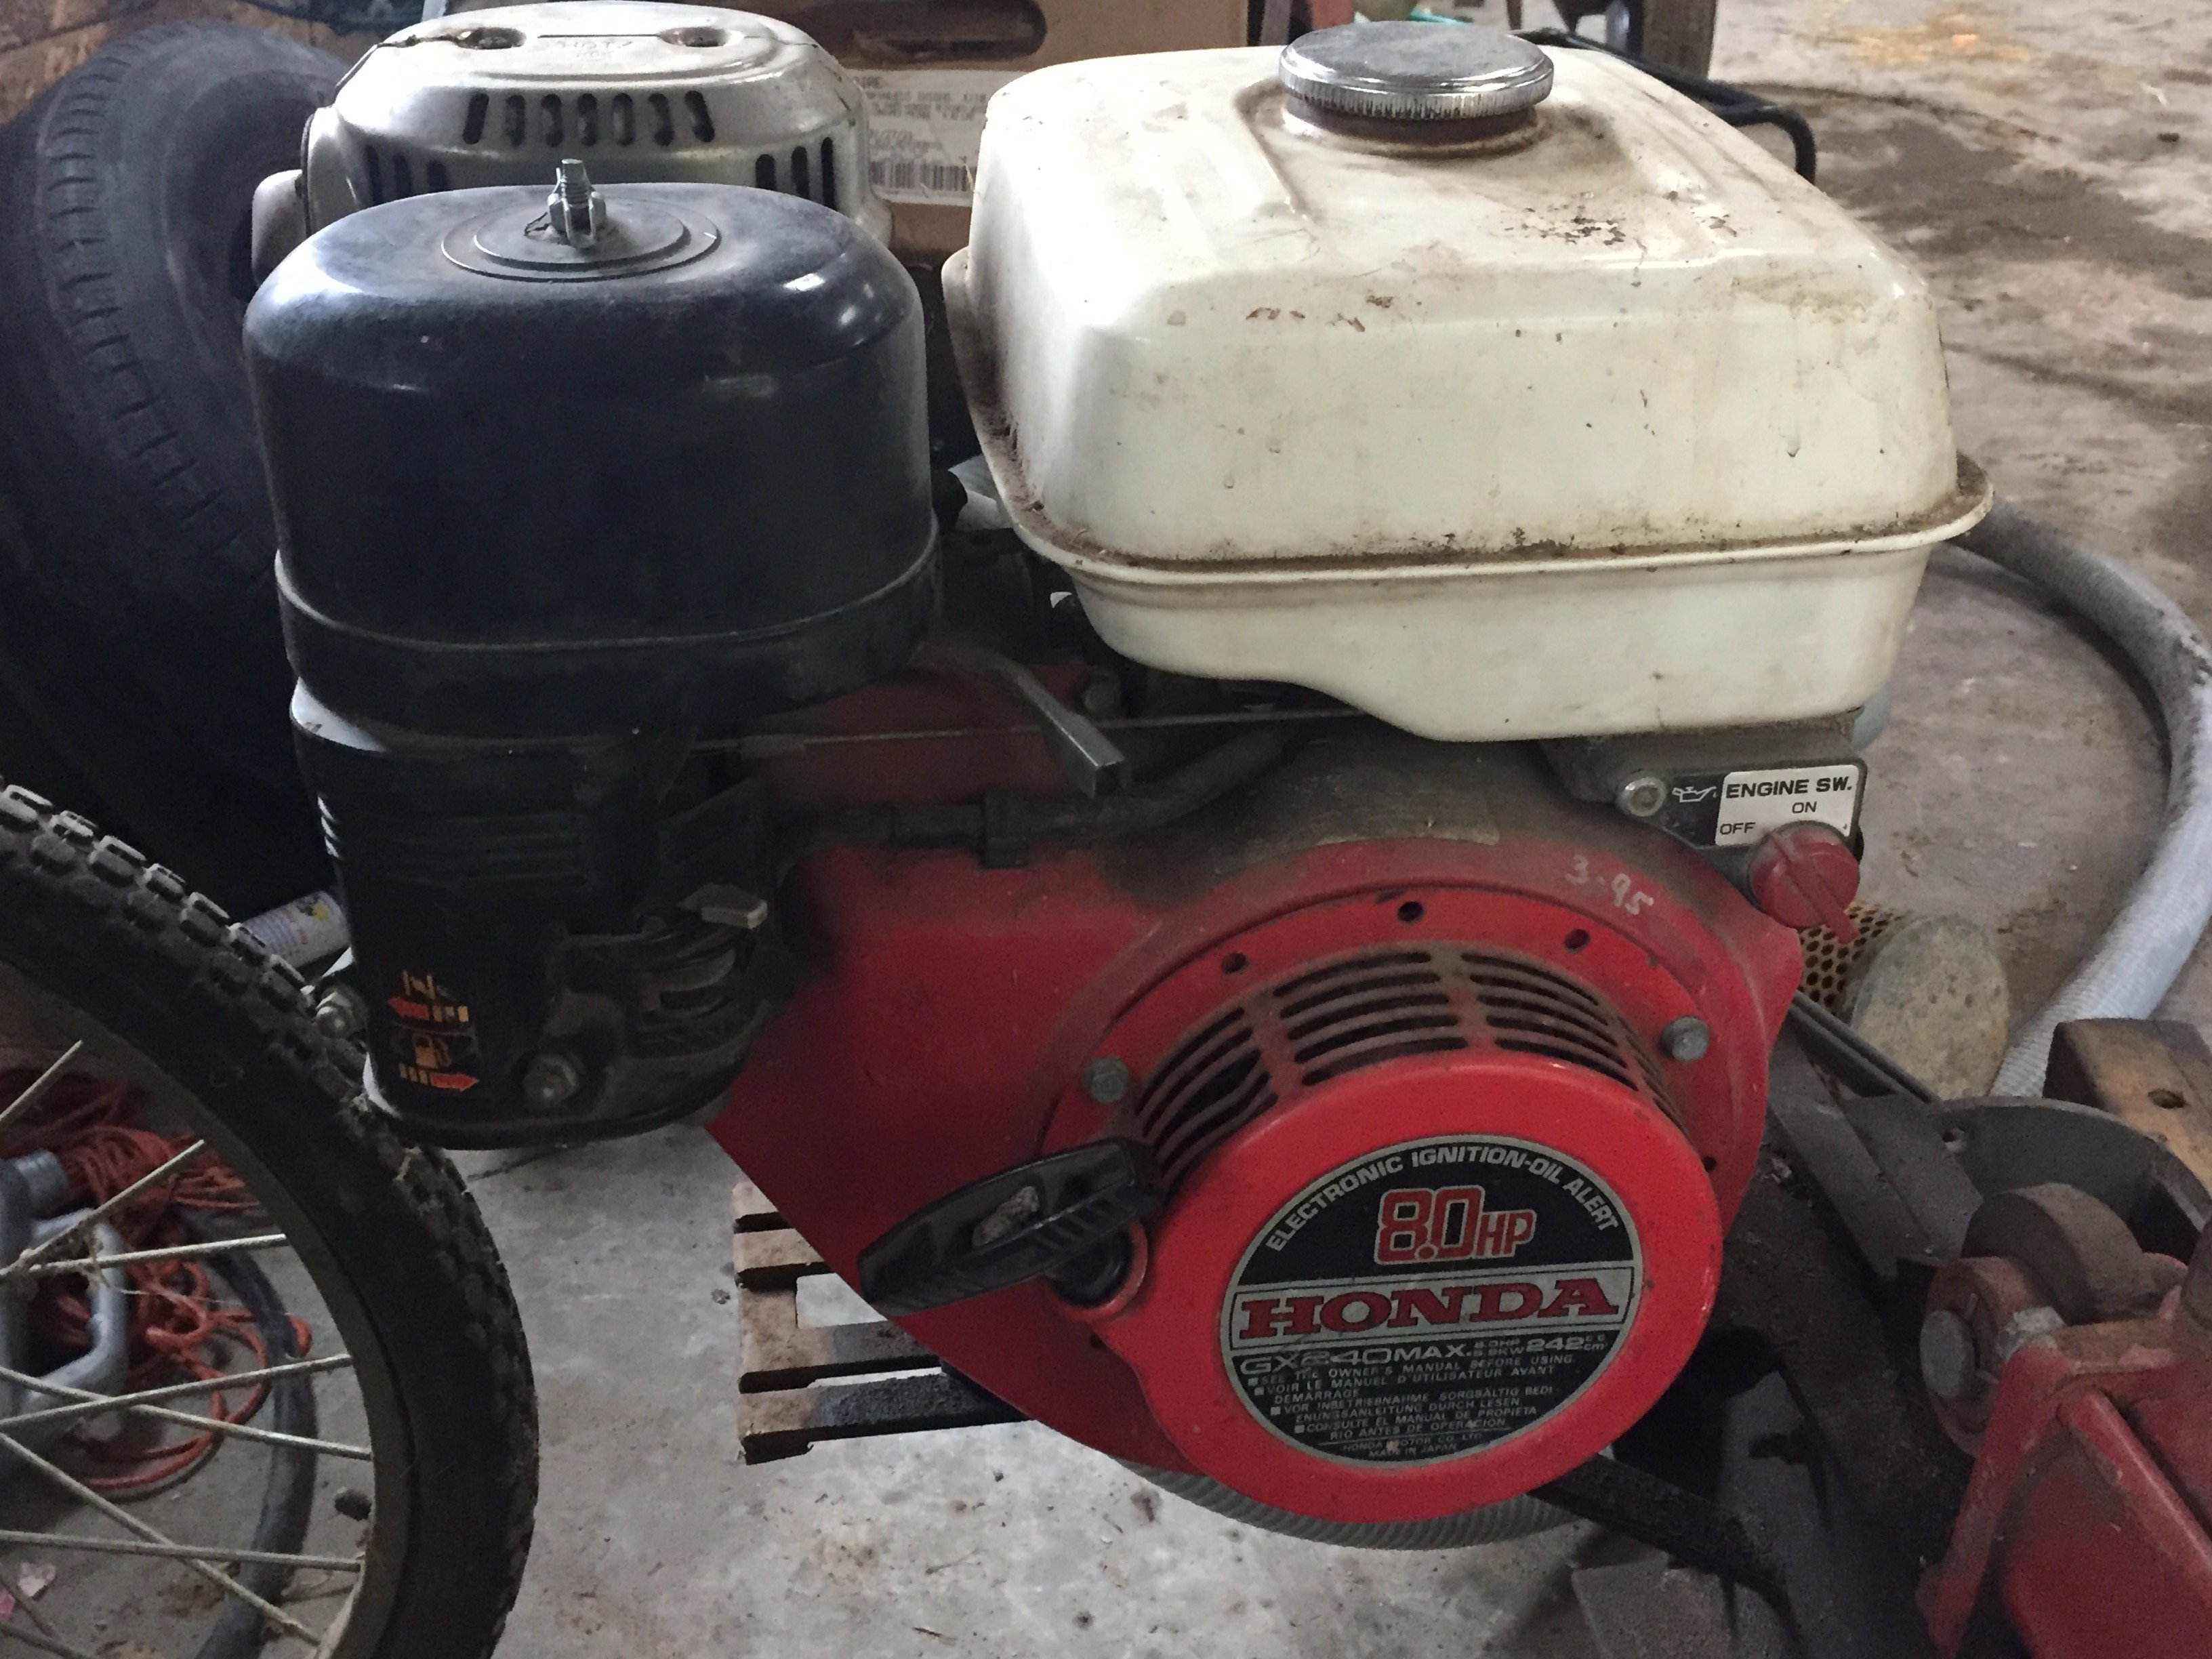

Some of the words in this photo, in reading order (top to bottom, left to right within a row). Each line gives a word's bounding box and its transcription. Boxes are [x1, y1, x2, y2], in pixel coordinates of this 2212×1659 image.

[1725, 779, 1809, 799] ENGINE
[1816, 777, 1852, 793] SW.
[1792, 802, 1817, 814] ON
[1719, 822, 1755, 835] OFF
[1265, 1156, 1404, 1252] ELECTRONIC
[1412, 1145, 1562, 1183] IGNITION-OIL
[1563, 1178, 1618, 1231] ALERT
[1241, 1277, 1619, 1339] HONDA
[1526, 1336, 1584, 1352] 242
[1403, 1361, 1460, 1373] MANUAL
[1471, 1357, 1520, 1368] BEFORE
[1267, 1383, 1298, 1393] VOIR
[1307, 1380, 1322, 1389] LE
[1332, 1376, 1387, 1388] MANUEL
[1511, 1365, 1553, 1376] AVANT
[1284, 1404, 1309, 1413] VOR
[1429, 1401, 1474, 1411] DURCH
[1307, 1420, 1368, 1431] CONSULTE
[1376, 1417, 1387, 1425] EL
[1395, 1413, 1445, 1423] MANUAL
[1455, 1410, 1470, 1419] DE
[1478, 1406, 1536, 1417] PROPIETA
[1330, 1430, 1353, 1439] RIO
[1359, 1426, 1399, 1437] ANTES
[1407, 1424, 1422, 1433] DE
[1387, 1438, 1430, 1446] OTOR
